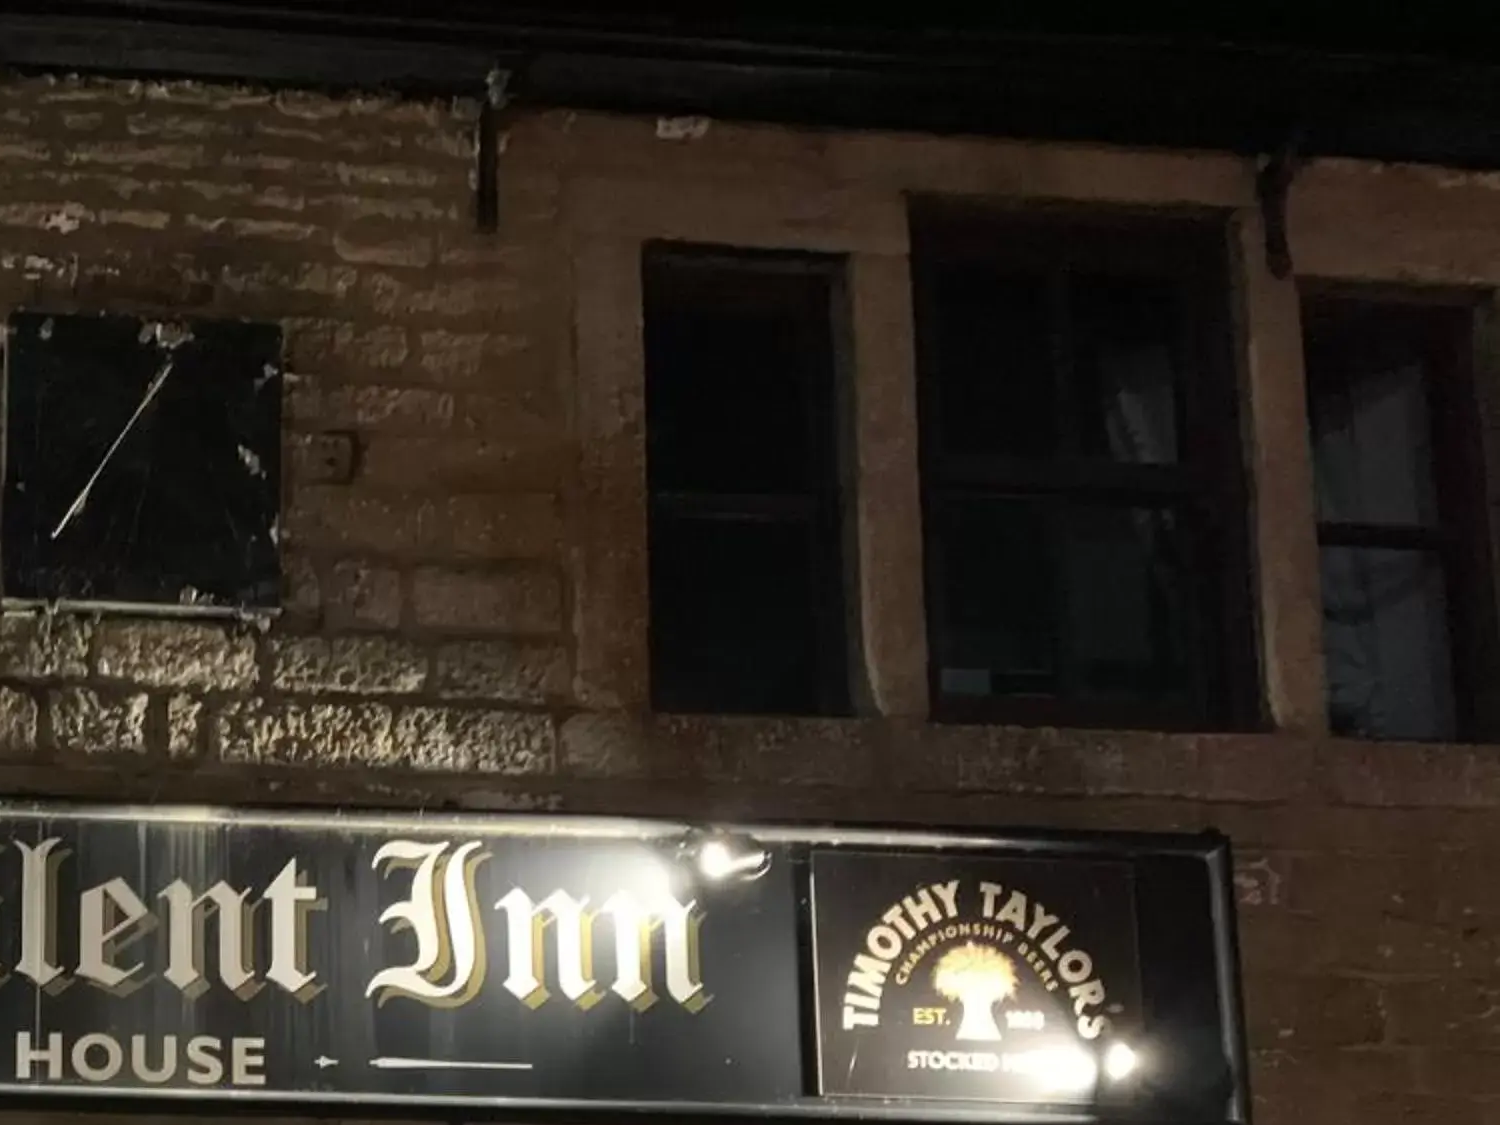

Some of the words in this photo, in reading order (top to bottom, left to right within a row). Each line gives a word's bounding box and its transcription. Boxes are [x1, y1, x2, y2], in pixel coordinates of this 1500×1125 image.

[365, 838, 714, 1013] Inn
[842, 880, 961, 1031] TIMOTHY
[895, 922, 1014, 986] CHAMPIONSHIP
[1016, 941, 1059, 993] BEERS
[912, 1007, 952, 1027] EST.
[14, 1031, 266, 1086] HOUSE
